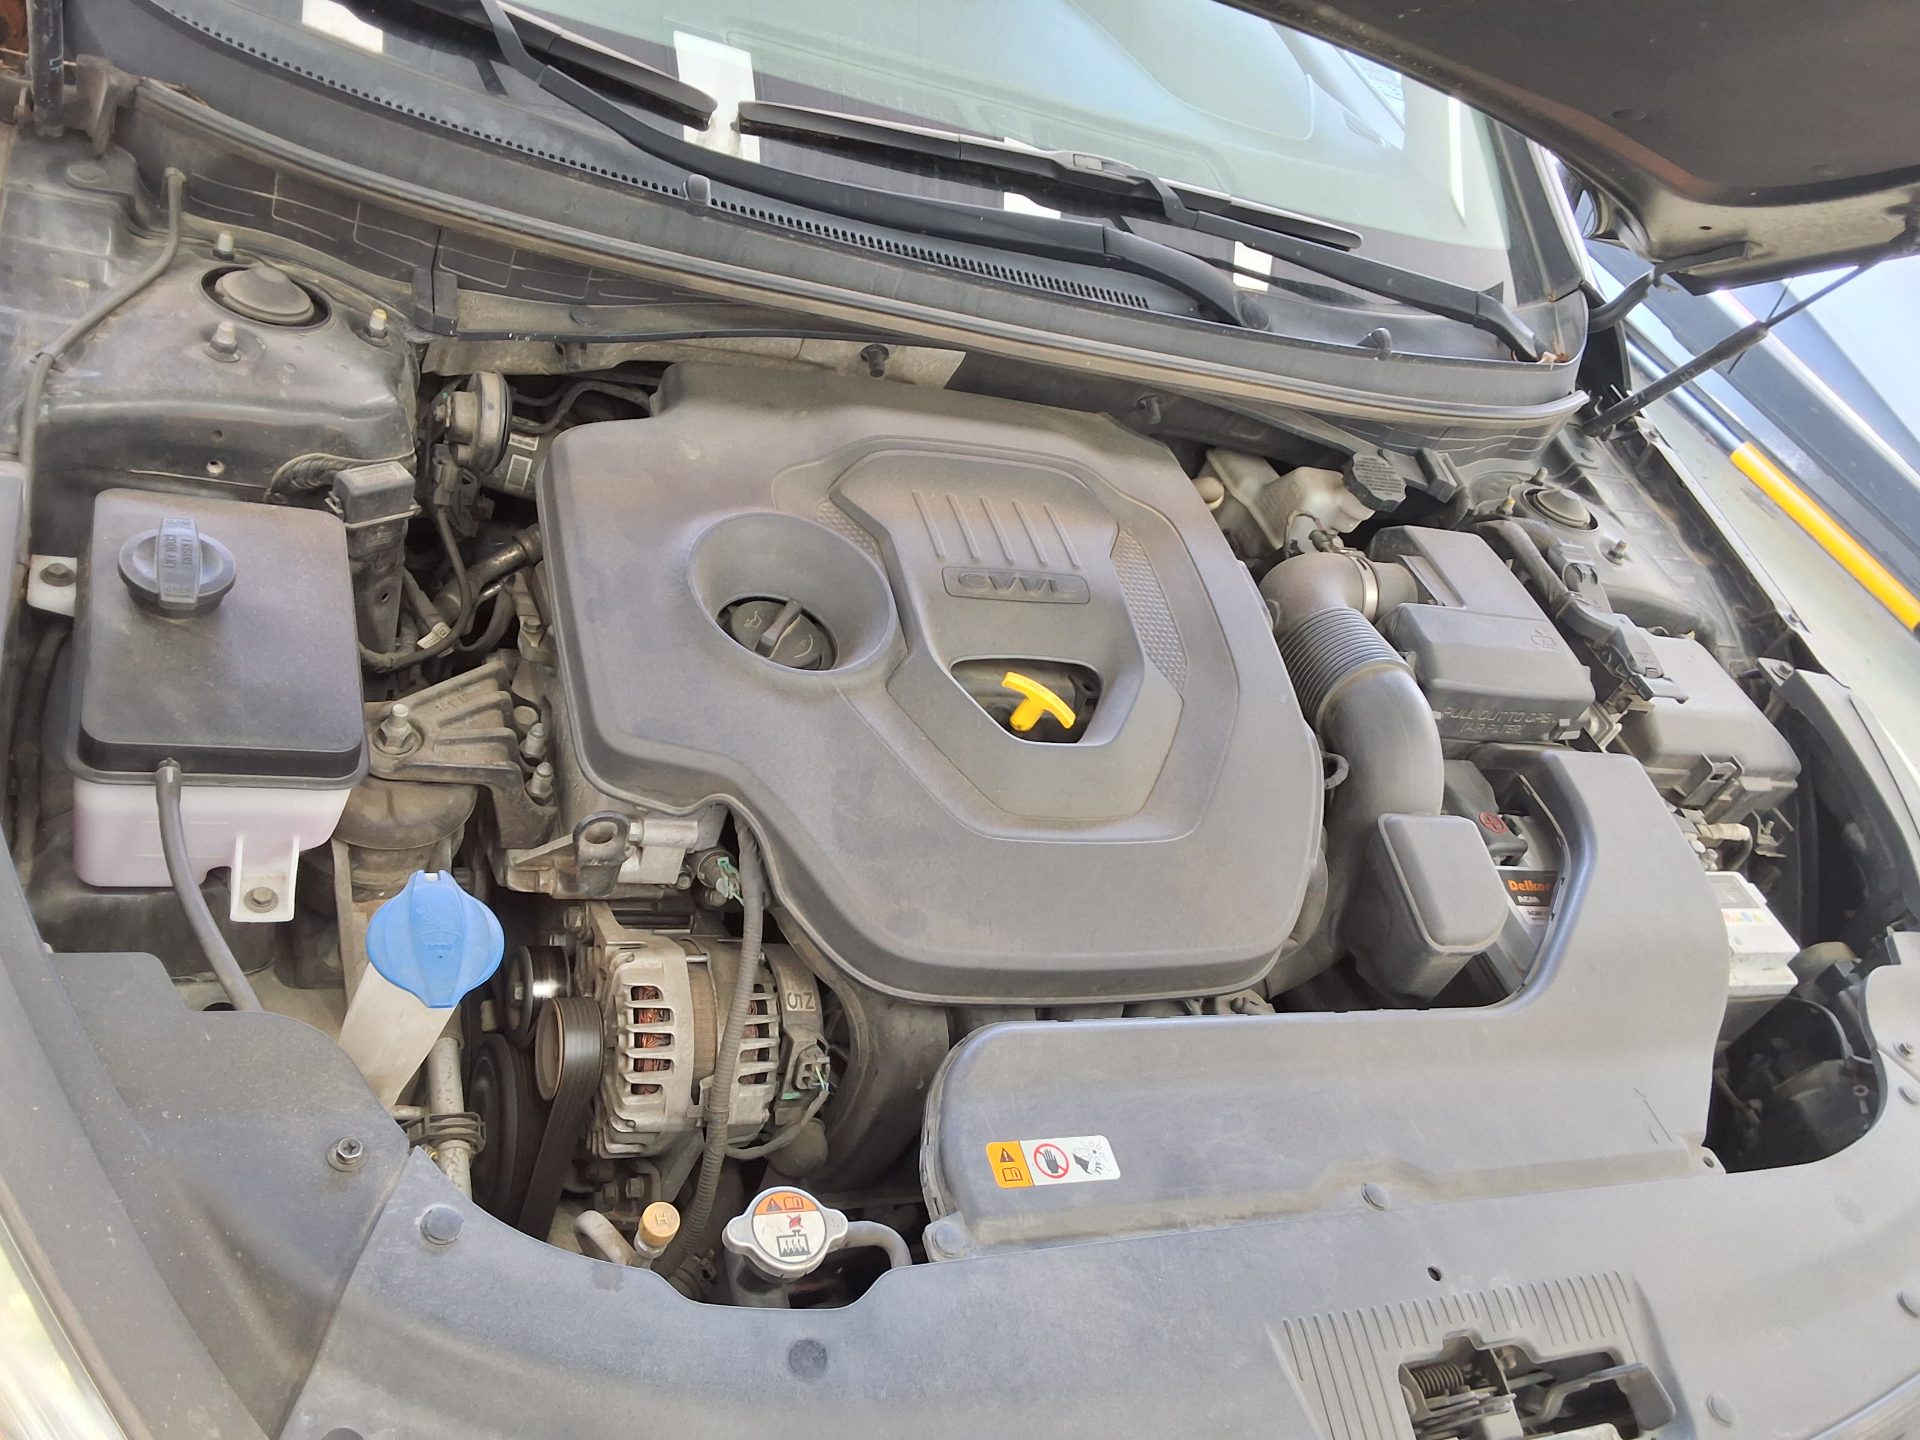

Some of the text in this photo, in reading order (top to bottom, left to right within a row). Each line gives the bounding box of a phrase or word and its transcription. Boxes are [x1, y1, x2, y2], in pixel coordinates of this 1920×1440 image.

[958, 572, 1078, 594] CVVL
[1443, 707, 1474, 720] PULL
[1507, 879, 1551, 892] Delkor
[654, 1212, 669, 1226] H
